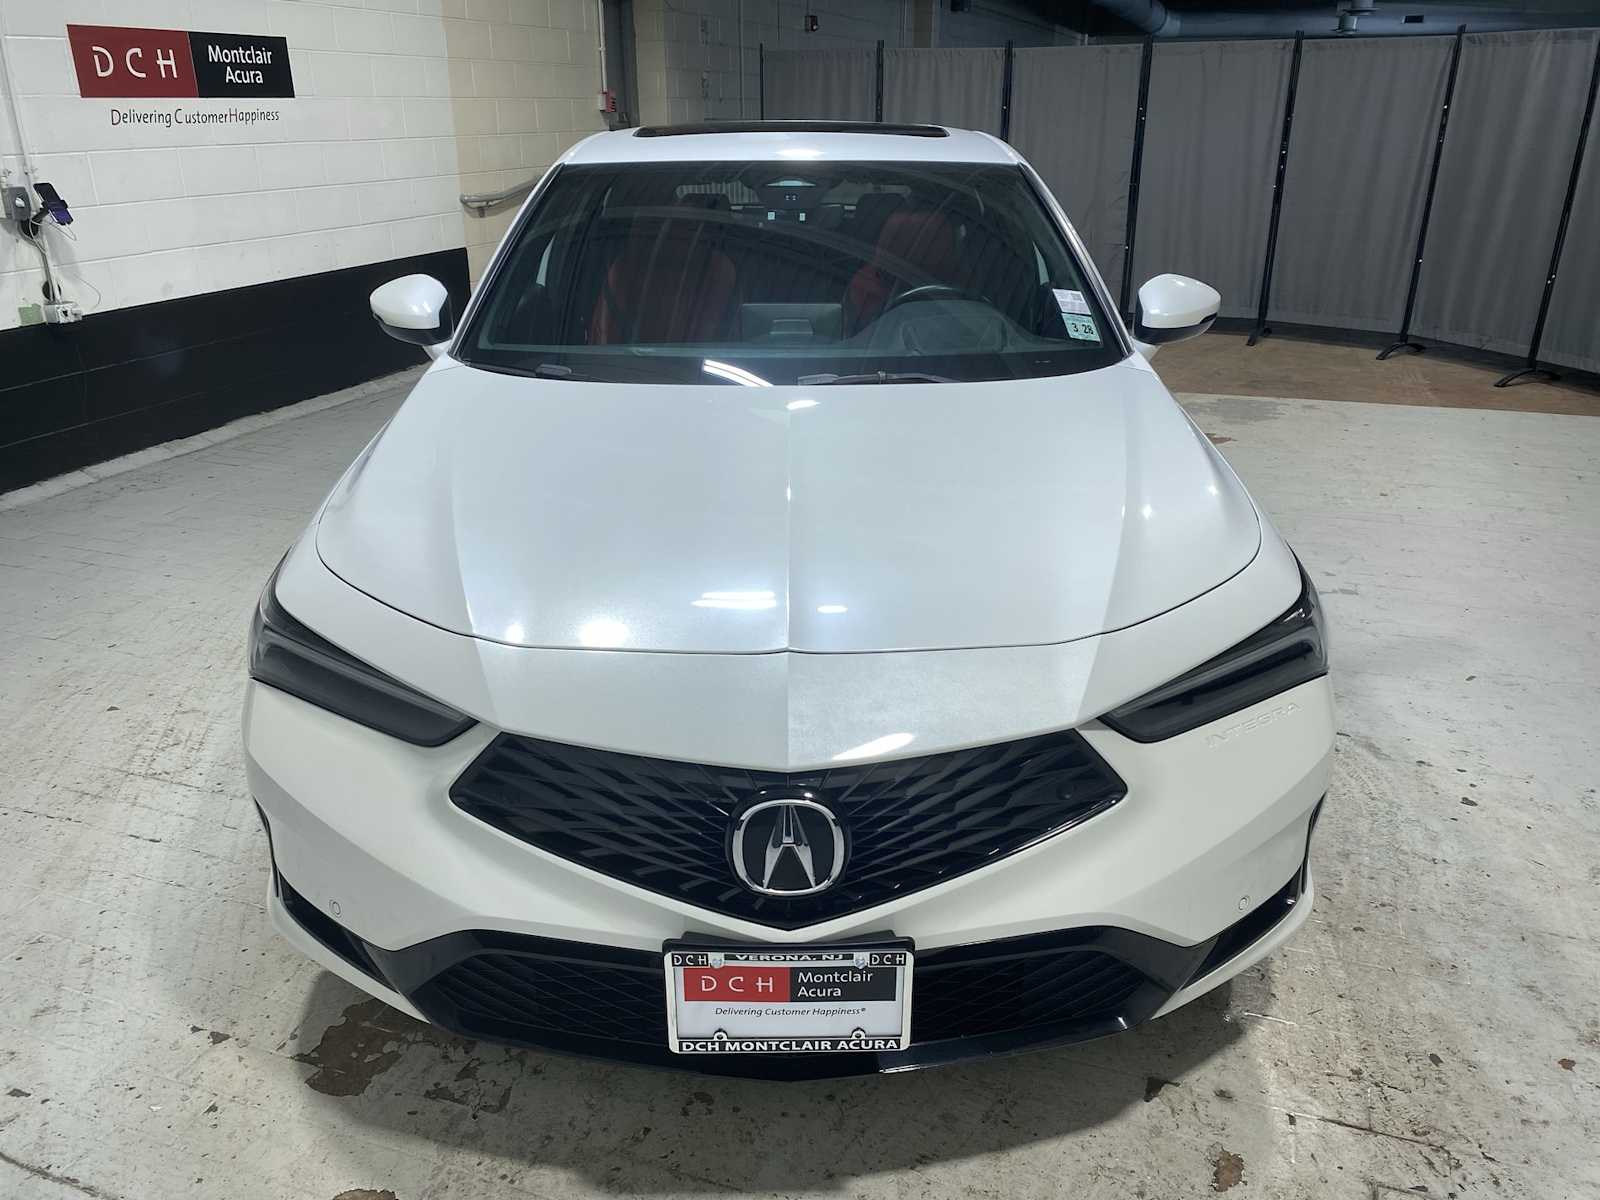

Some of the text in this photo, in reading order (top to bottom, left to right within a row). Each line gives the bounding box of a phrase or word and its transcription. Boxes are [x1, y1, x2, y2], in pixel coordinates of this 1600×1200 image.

[207, 45, 273, 65] Montclair
[225, 66, 264, 84] Acura
[111, 108, 280, 127] Delivering Customer Happiness
[1204, 702, 1301, 747] INTEGRA
[821, 953, 844, 961] NJ
[797, 970, 873, 983] Montclair
[797, 985, 842, 998] Acura
[715, 1007, 763, 1017] Delivering
[765, 1007, 810, 1016] Customer
[682, 1039, 898, 1051] DCH MONTCLAIR ACURA
